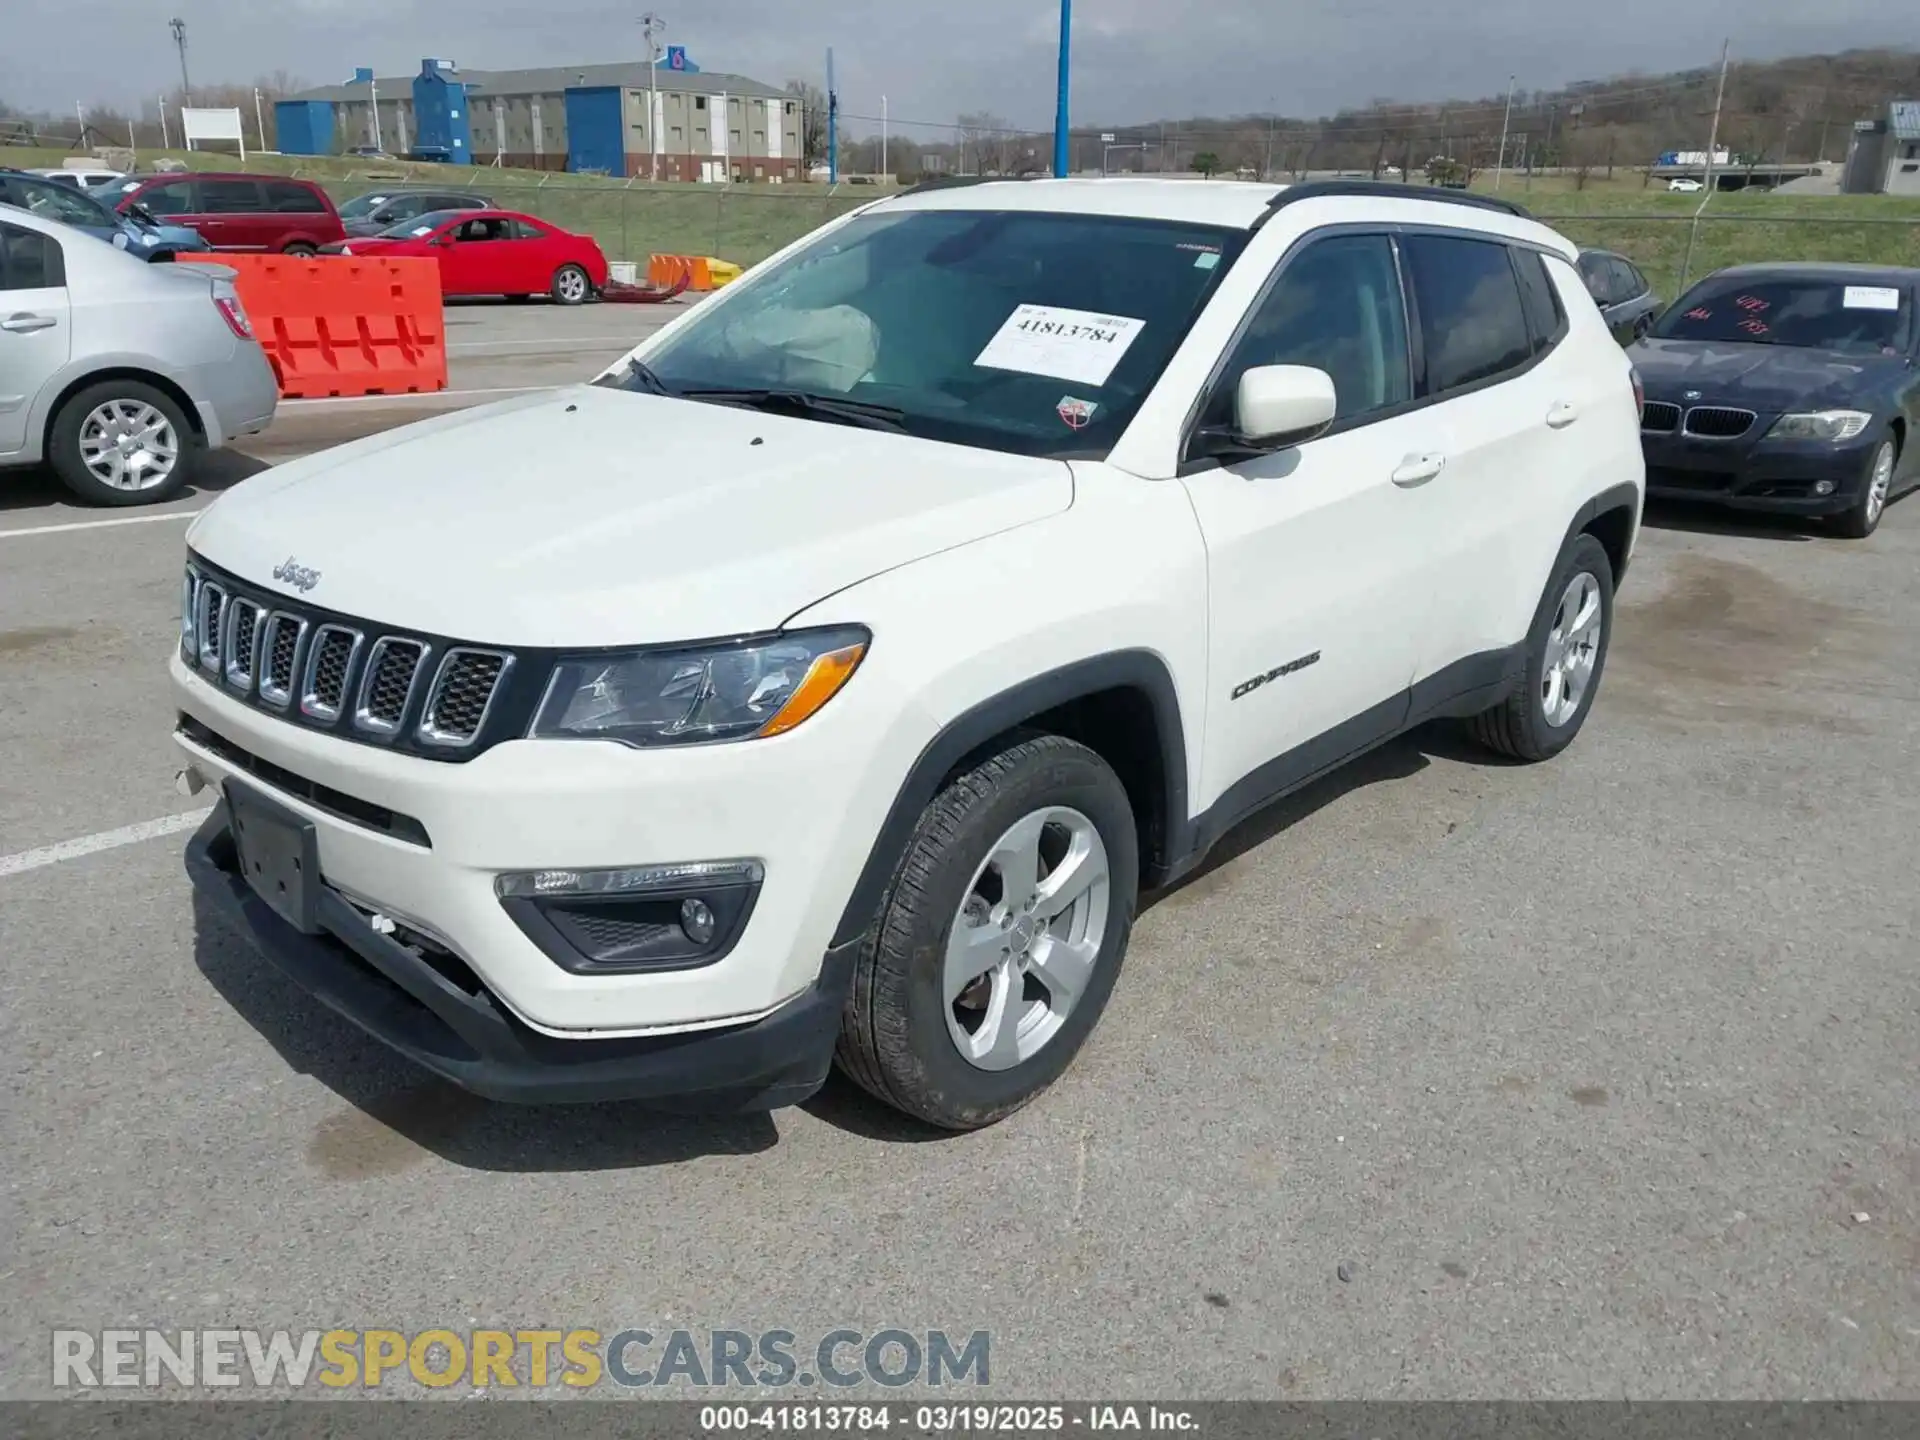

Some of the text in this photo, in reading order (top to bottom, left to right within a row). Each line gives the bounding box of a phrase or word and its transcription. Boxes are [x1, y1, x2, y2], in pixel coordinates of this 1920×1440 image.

[672, 50, 684, 69] 6
[1017, 319, 1118, 343] 41813784
[273, 555, 321, 593] Jeep
